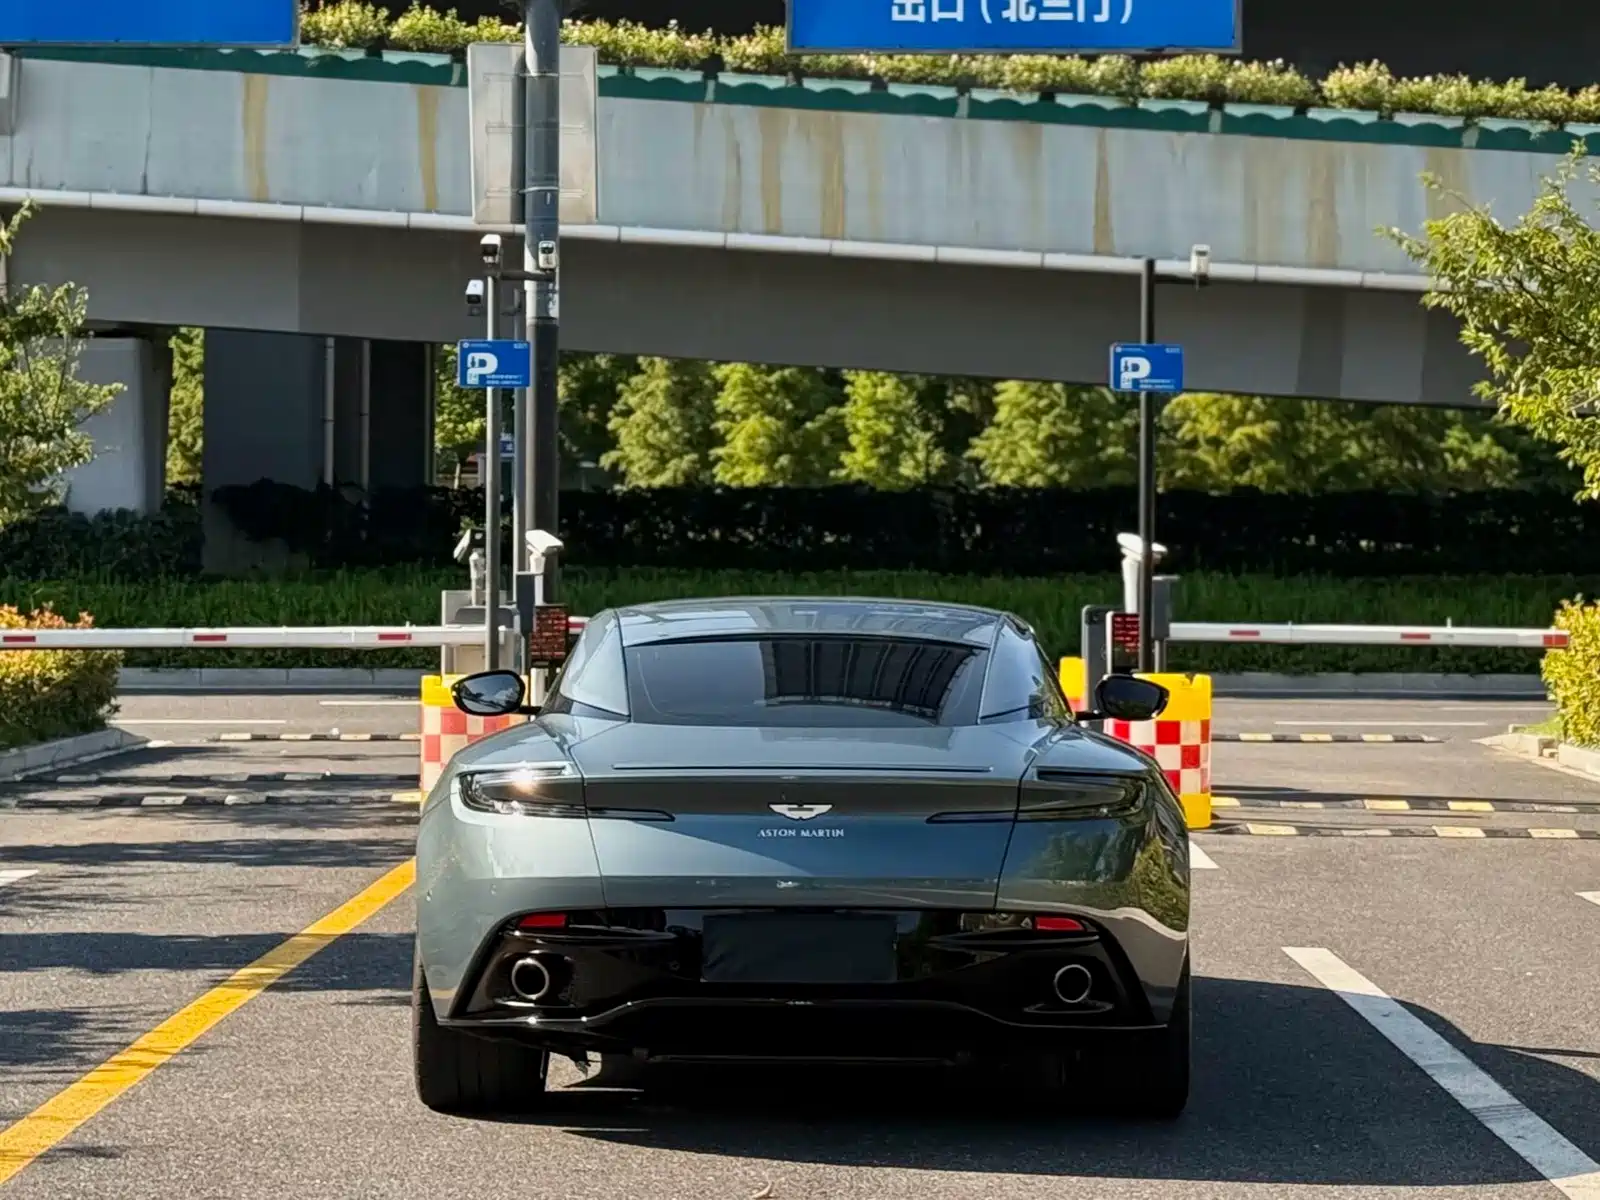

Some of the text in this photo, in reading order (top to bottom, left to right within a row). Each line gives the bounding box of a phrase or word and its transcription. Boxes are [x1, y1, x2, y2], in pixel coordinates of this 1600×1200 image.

[467, 352, 498, 385] P
[1120, 356, 1151, 389] P
[757, 828, 844, 838] ASTON MARTIN
